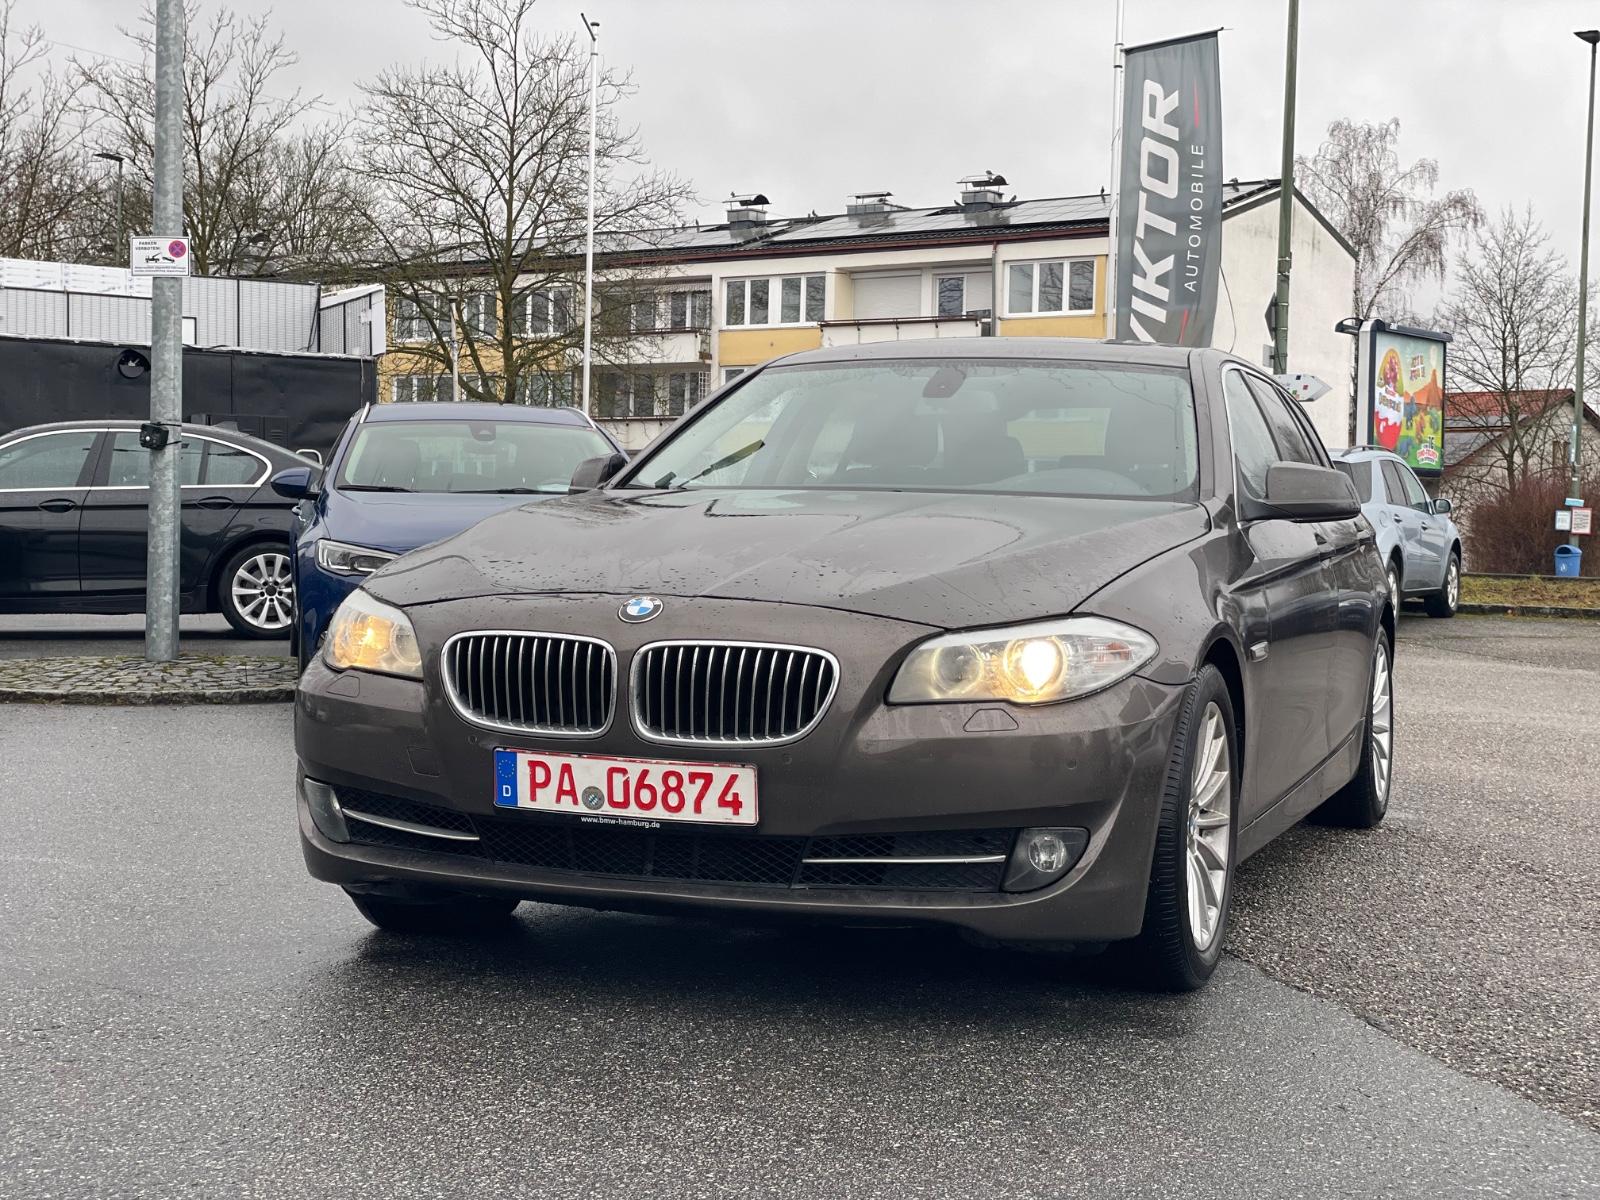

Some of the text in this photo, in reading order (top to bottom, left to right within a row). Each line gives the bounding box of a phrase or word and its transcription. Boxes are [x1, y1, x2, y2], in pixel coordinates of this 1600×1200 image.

[1184, 144, 1204, 293] AUTOMOBILE
[502, 784, 512, 798] D
[527, 759, 743, 816] PA 06874
[580, 815, 661, 829] www.bmw-hamburg.de
